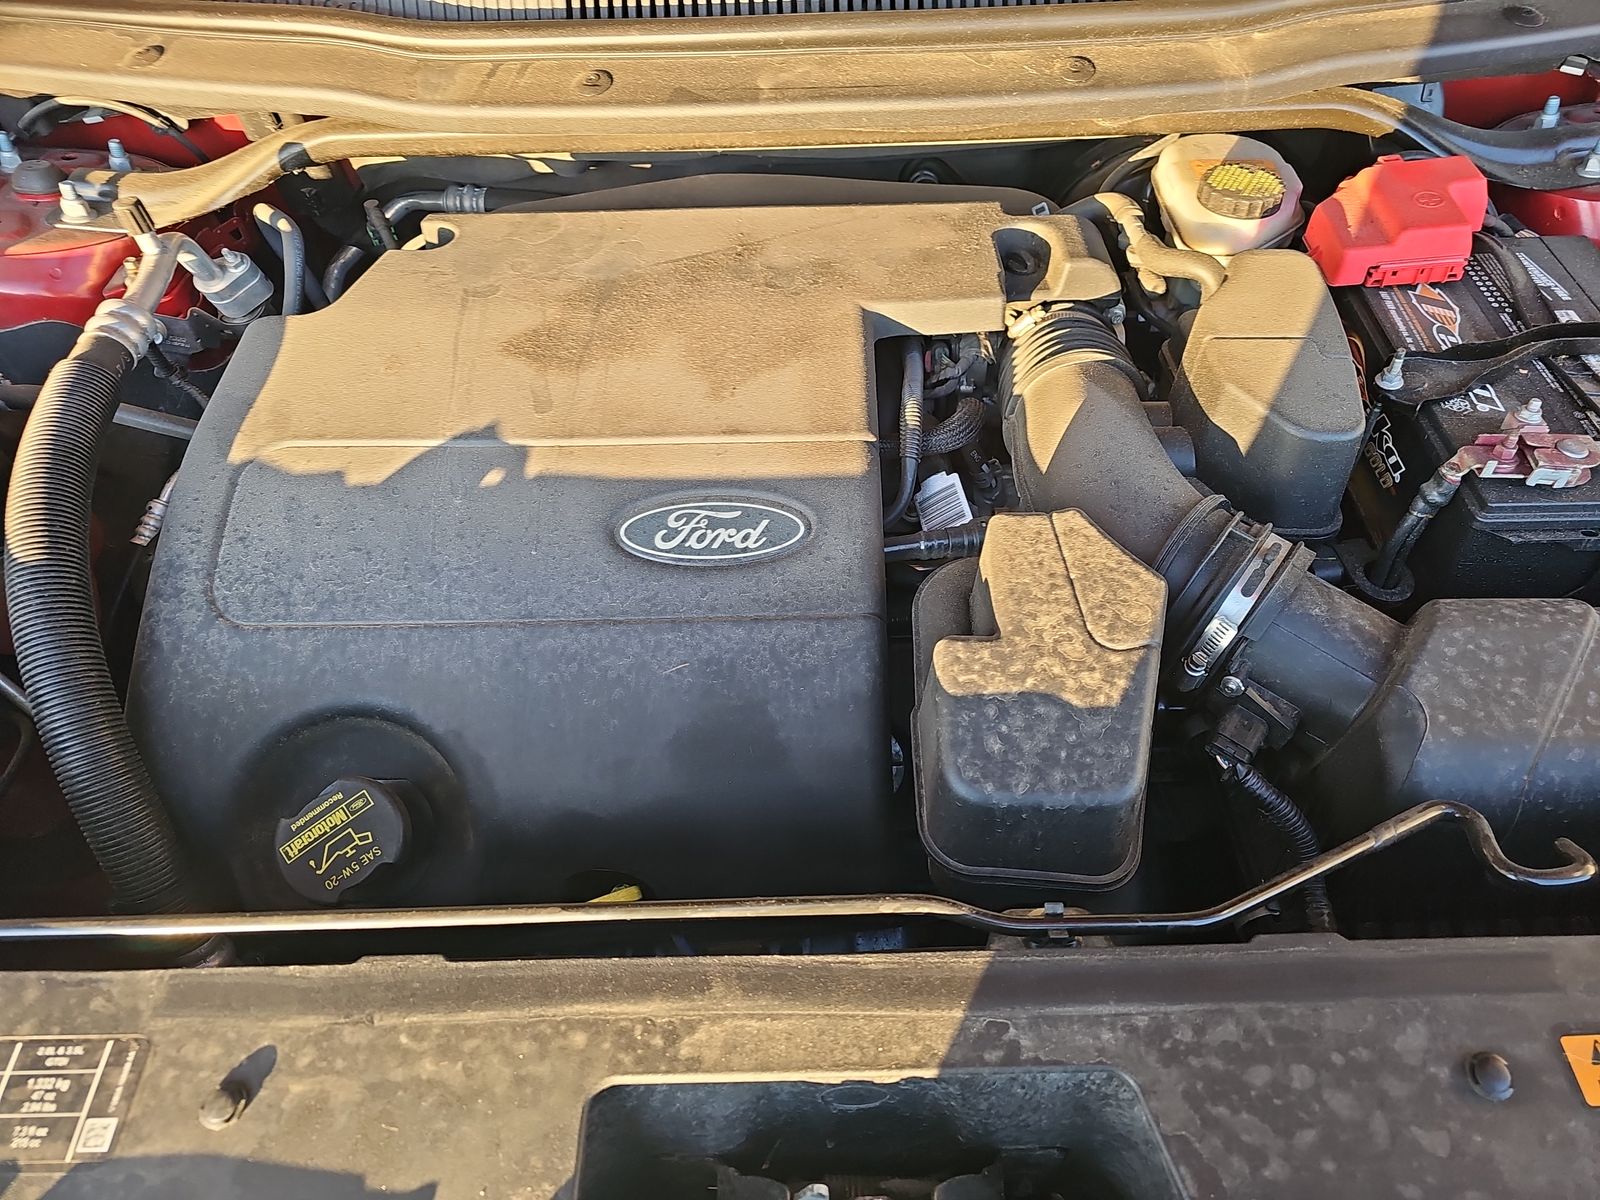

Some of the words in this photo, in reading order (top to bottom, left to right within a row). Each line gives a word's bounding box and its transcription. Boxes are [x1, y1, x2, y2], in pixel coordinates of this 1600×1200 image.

[654, 509, 770, 550] Ford
[290, 791, 344, 831] Recommended
[282, 807, 348, 858] Motorcraft
[324, 860, 361, 890] 5W-20
[358, 846, 382, 866] SAE
